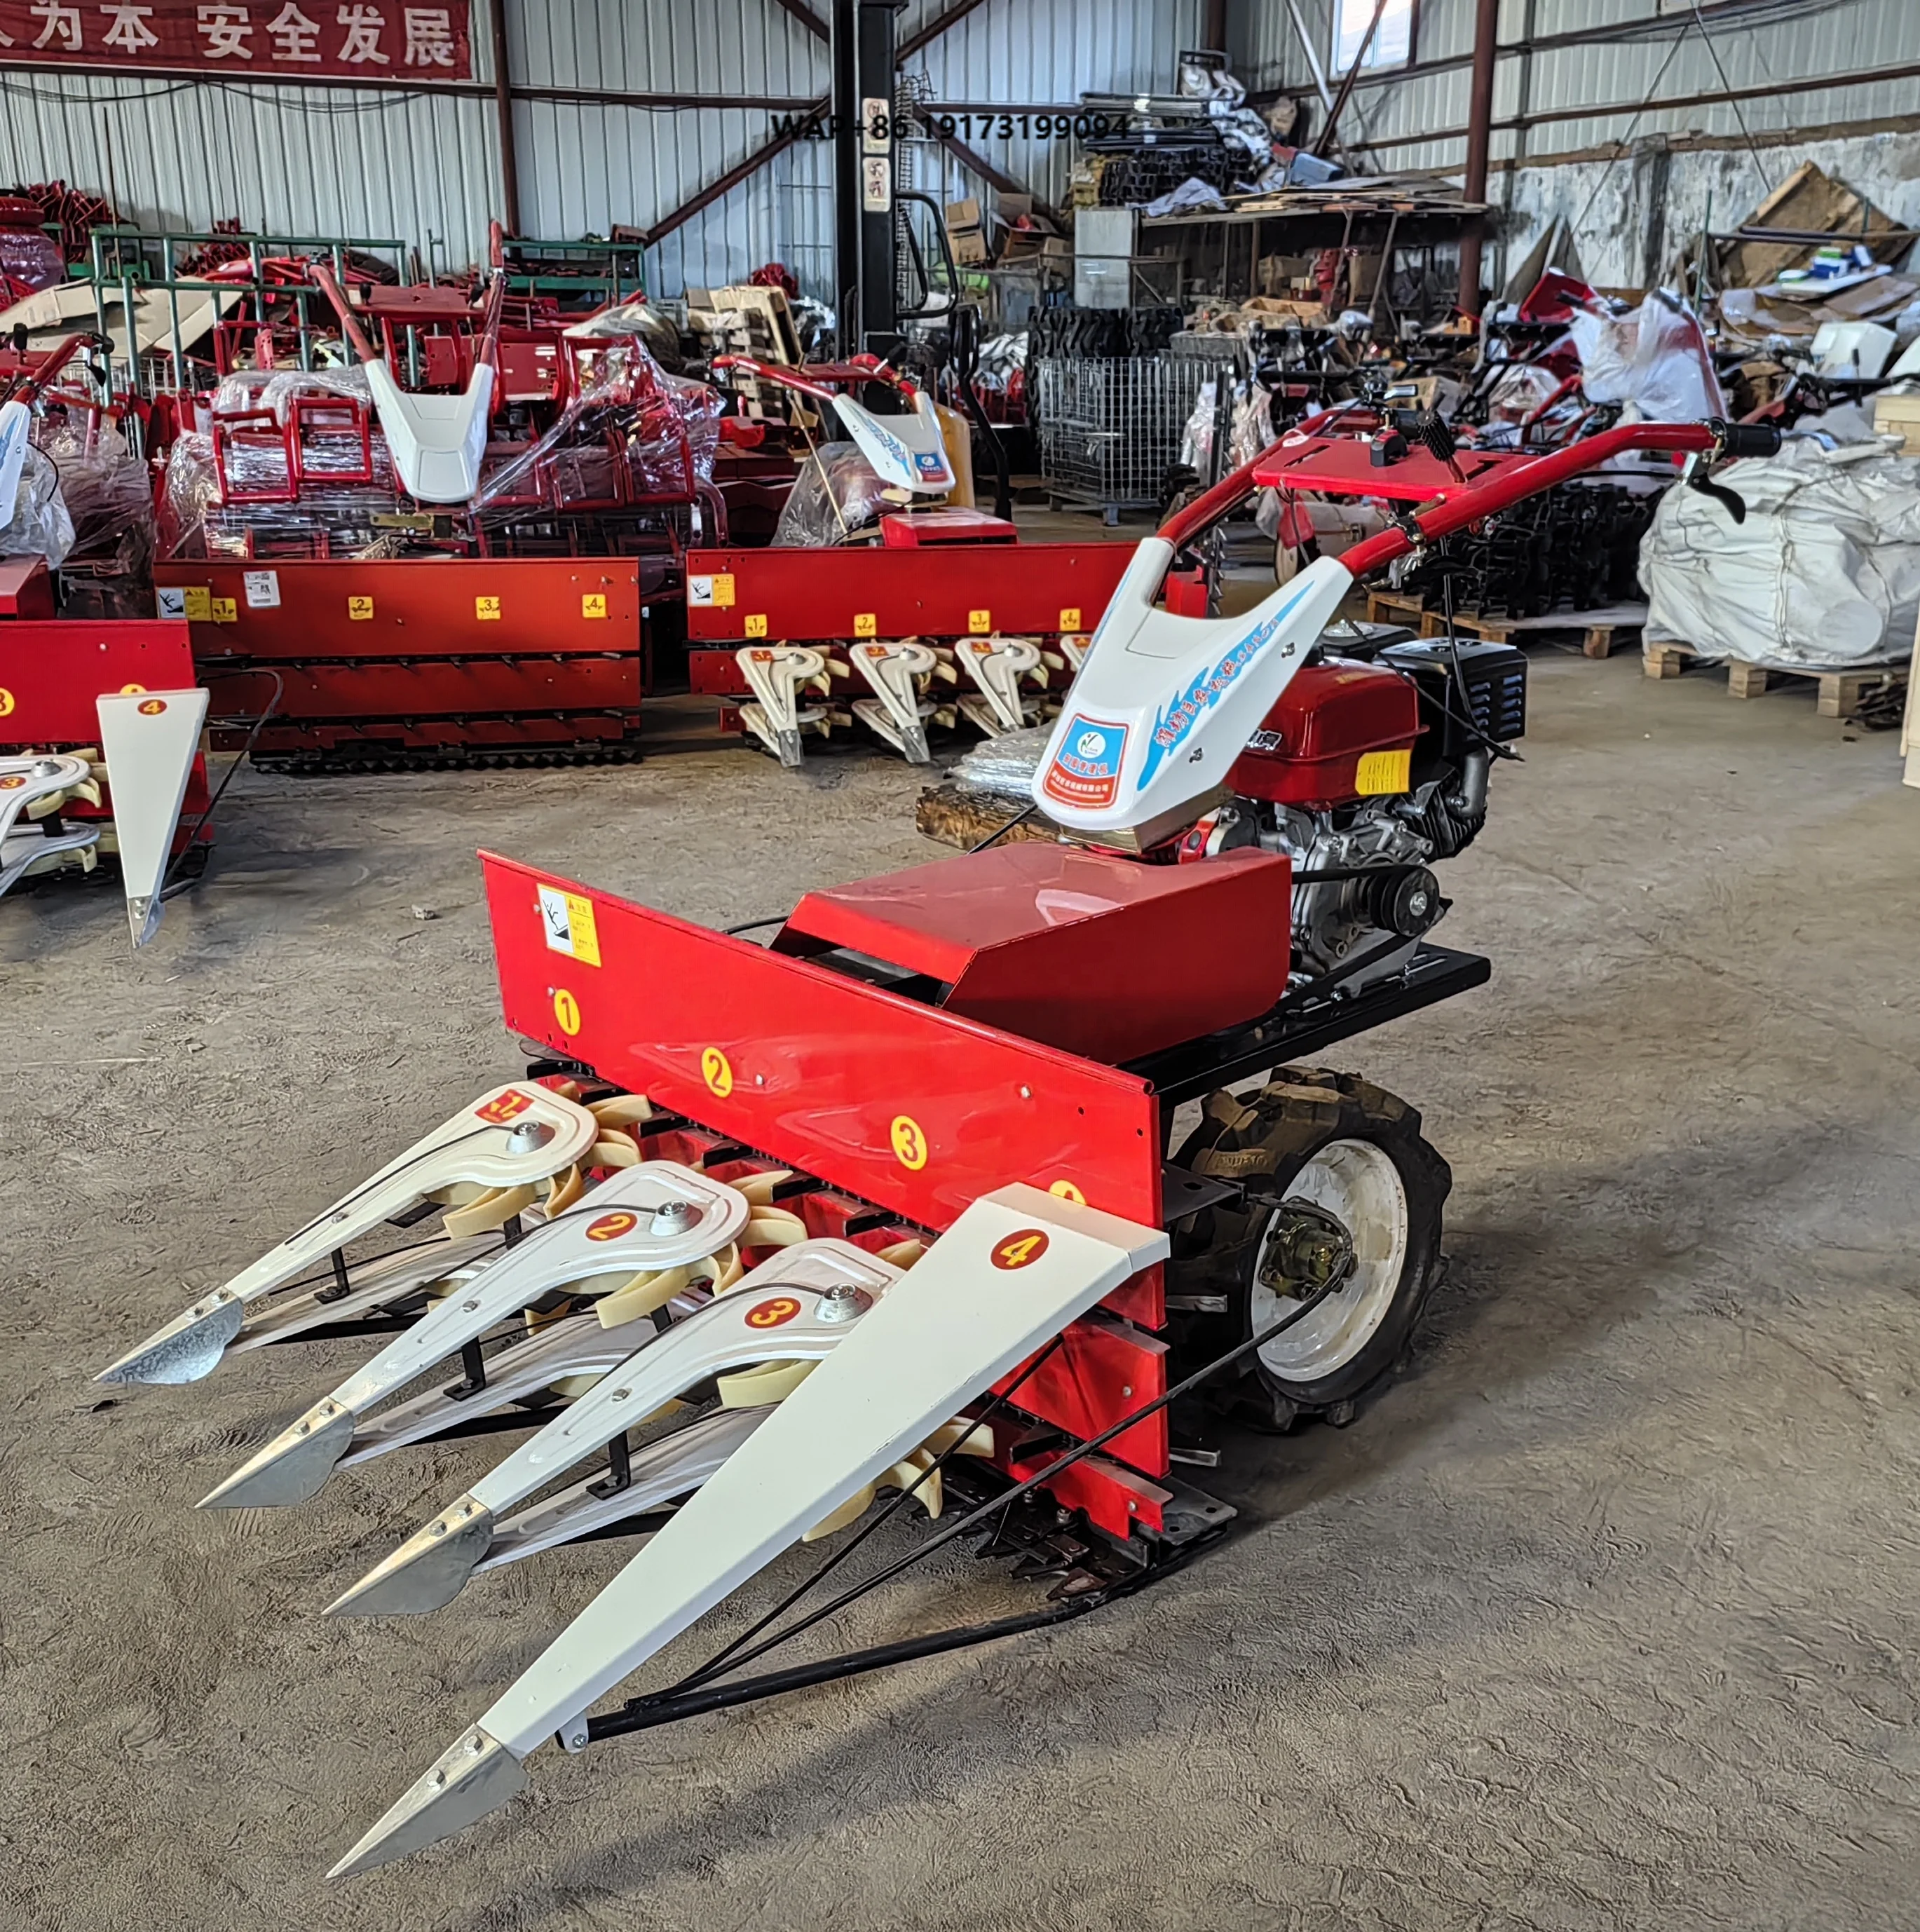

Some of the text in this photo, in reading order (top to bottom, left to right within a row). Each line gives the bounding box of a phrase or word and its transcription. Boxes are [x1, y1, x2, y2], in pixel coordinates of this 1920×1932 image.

[0, 0, 456, 67] 为本 安全发展
[143, 700, 161, 714] 4
[708, 1054, 727, 1091] 2
[899, 1122, 918, 1162] 3
[588, 1214, 631, 1239] 2
[1000, 1234, 1042, 1266] 4
[751, 1300, 794, 1325] 3
